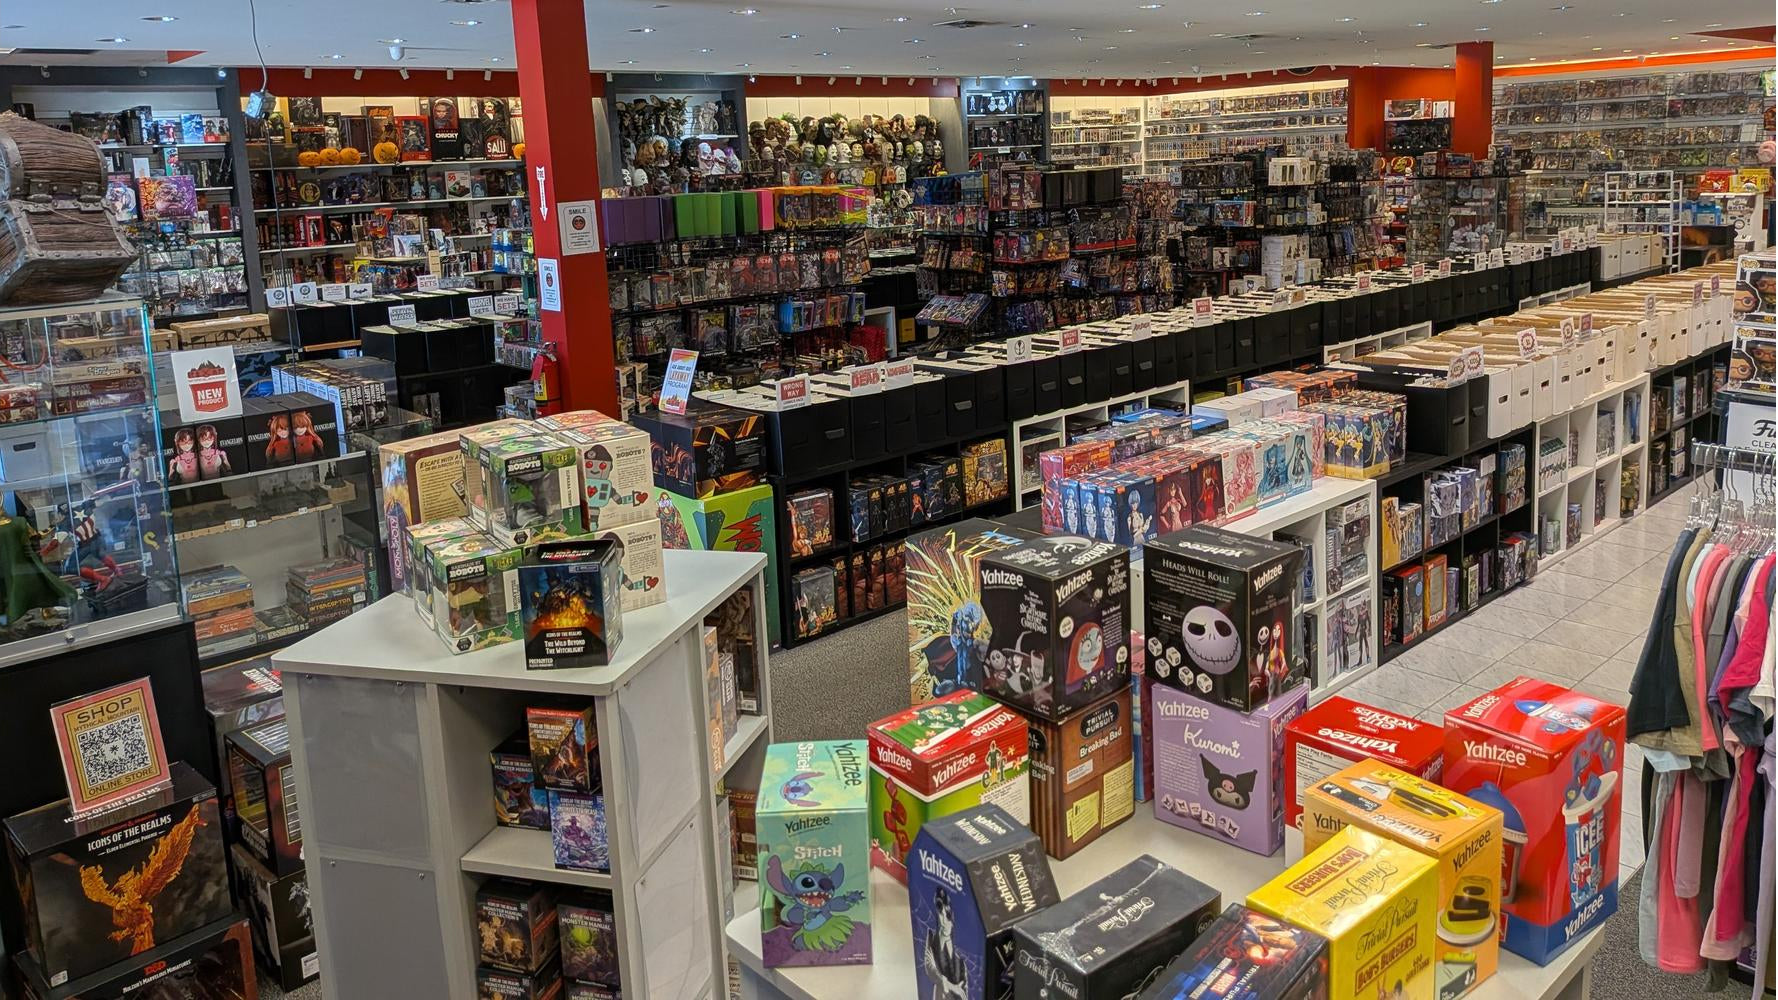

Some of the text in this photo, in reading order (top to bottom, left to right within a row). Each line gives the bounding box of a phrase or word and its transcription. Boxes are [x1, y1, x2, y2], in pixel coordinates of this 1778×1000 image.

[487, 139, 506, 154] SAW
[498, 302, 516, 310] SETS
[196, 388, 222, 400] NEW
[783, 382, 804, 391] WRONG
[198, 396, 224, 406] PRODUCT
[248, 432, 271, 442] EVANGELION
[314, 422, 336, 431] EVANGELION
[220, 437, 243, 447] EVANGELION
[420, 458, 441, 469] ESCAPE
[508, 460, 541, 472] ROBOTS
[390, 516, 404, 579] MONOPOLY
[1178, 540, 1244, 558] Yahtzee
[450, 566, 485, 578] ROBOTS
[981, 569, 1024, 586] Yahtzee
[1162, 558, 1230, 585] HEADS WILL ROLL!
[1253, 563, 1283, 592] Yahtzee
[1056, 569, 1093, 602] Yahtzee
[544, 638, 586, 648] THE WILD BEYOND
[556, 646, 584, 654] WITCHLIGHT
[74, 706, 140, 732] MYTHICAL MOUNTAIN
[77, 697, 132, 724] SHOP
[1086, 708, 1114, 726] TRIVIAL
[1156, 700, 1210, 720] Yahtzee
[1353, 706, 1418, 732] NOODLES
[1463, 695, 1500, 719] Yahtzee
[970, 712, 1016, 738] Yahtzee
[1085, 716, 1114, 736] PURSUIT
[1080, 726, 1123, 758] Breaking Bad
[1183, 724, 1241, 759] Kuromi
[1318, 727, 1399, 753] Yahtzee
[1463, 740, 1527, 766] Yahtzee
[832, 742, 862, 788] Yahtzee
[876, 746, 912, 772] Yahtzee
[932, 752, 976, 788] Yahtzee
[88, 768, 154, 796] ONLINE STORE
[1031, 768, 1047, 782] Bad
[64, 810, 91, 824] ICONS
[125, 786, 162, 802] REALMS
[88, 836, 112, 852] ICONS
[112, 832, 123, 844] OF
[124, 826, 140, 840] THE
[141, 814, 172, 833] REALMS
[784, 815, 832, 835] Yahtzee
[974, 814, 1008, 835] Yahtzee
[1372, 814, 1443, 843] Yahtzee
[1574, 809, 1604, 858] ICEE
[1452, 829, 1492, 872] Yahtzee
[918, 848, 964, 892] Yahtzee
[1008, 852, 1037, 913] WEDNESDAY
[1293, 850, 1362, 892] BOB'S BURGERS
[991, 864, 1018, 912] Yahtzee
[1322, 860, 1398, 910] Trivial Pursuit
[562, 918, 611, 930] MONSTER MANUAL
[1098, 896, 1156, 932] Trivial Pursuit
[1564, 894, 1604, 940] Yahtzee
[1356, 897, 1418, 960] Trivial Pursuit
[1018, 950, 1079, 1000] Trivial Pursuit
[1358, 934, 1414, 990] BOB'S BURGERS
